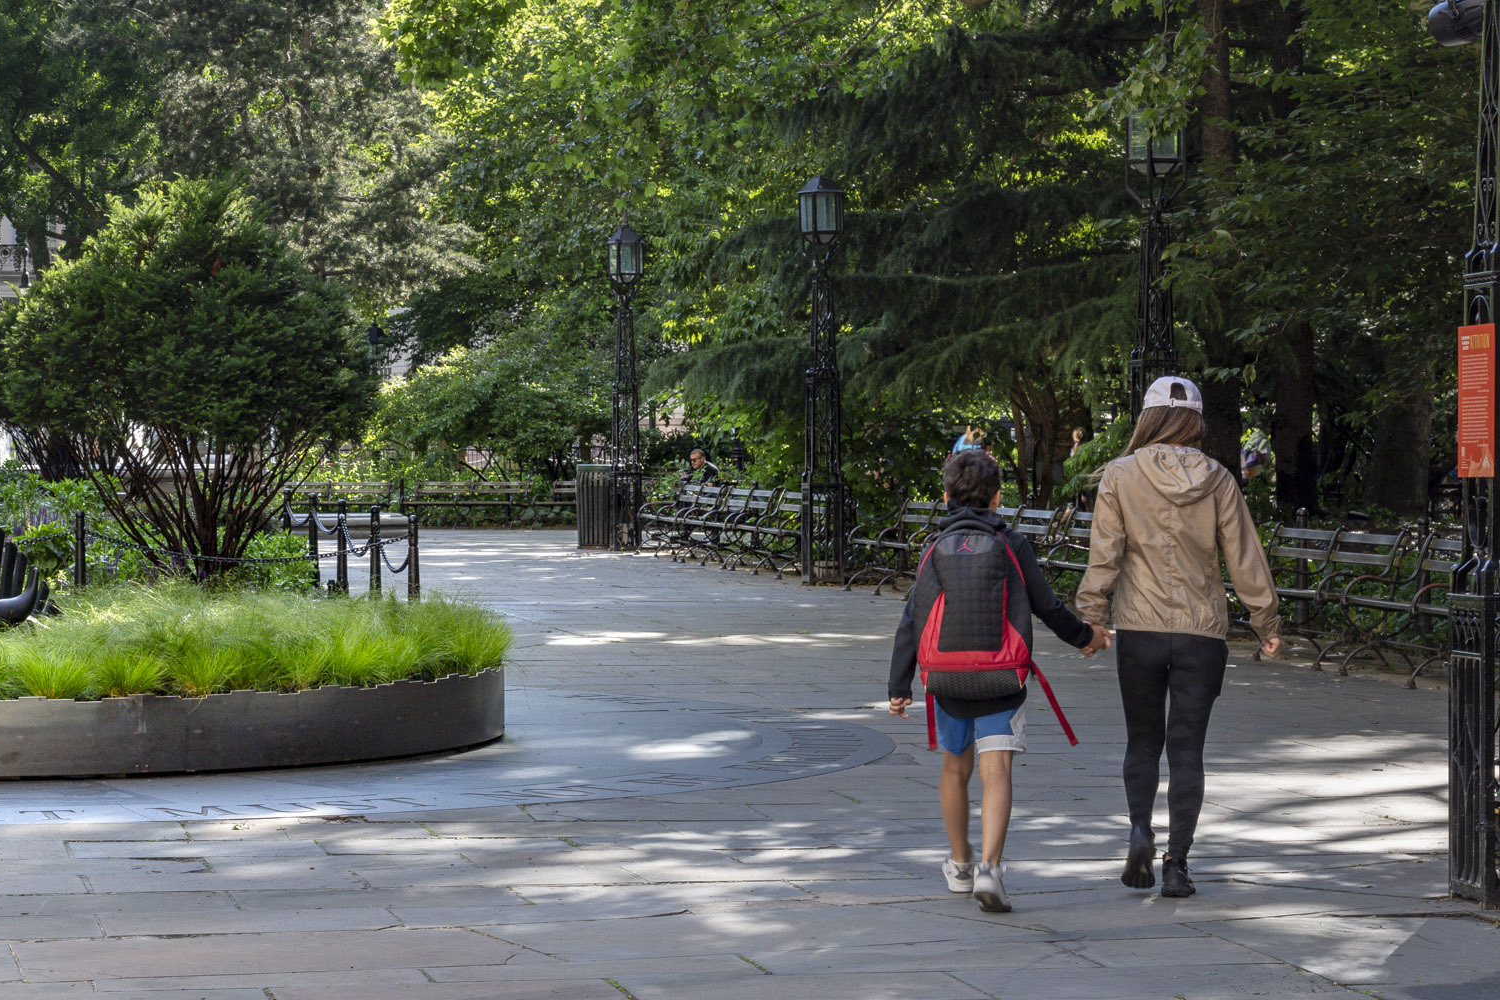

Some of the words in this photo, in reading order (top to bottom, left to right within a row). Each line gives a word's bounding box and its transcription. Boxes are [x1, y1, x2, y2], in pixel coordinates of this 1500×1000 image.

[151, 797, 439, 818] MUST
[460, 784, 643, 802] NOT
[617, 774, 745, 787] BE
